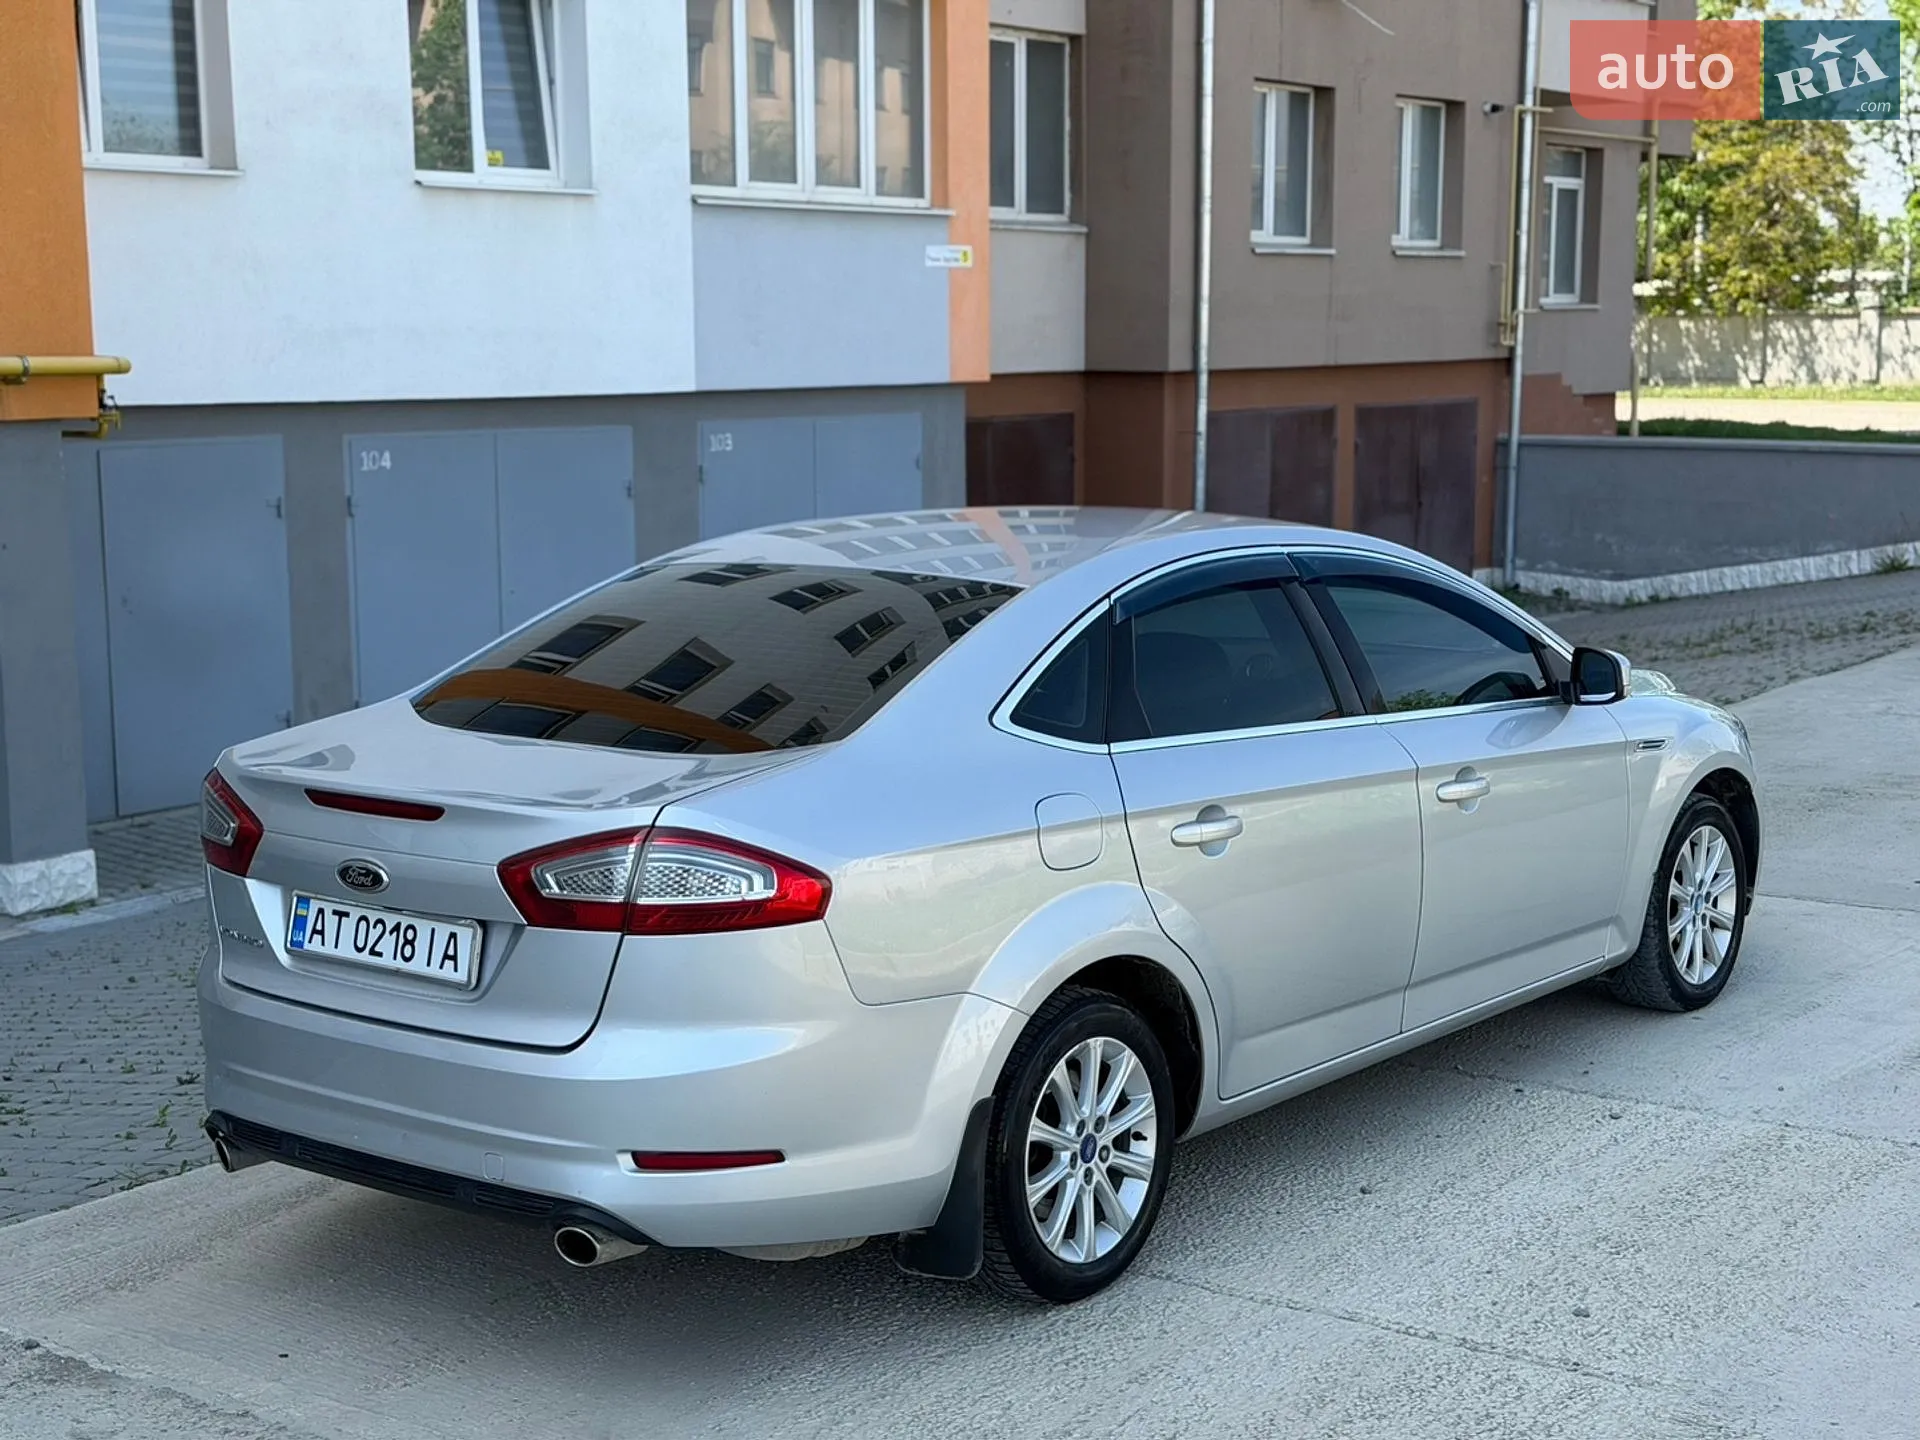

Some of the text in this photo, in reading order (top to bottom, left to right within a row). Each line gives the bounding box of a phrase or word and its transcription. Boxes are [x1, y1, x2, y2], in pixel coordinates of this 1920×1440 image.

[709, 432, 733, 452] 103
[360, 450, 392, 471] 104
[346, 865, 373, 886] Ford
[292, 929, 304, 942] UA
[308, 907, 350, 950] AT
[353, 914, 417, 963] 0218
[426, 927, 459, 973] IA
